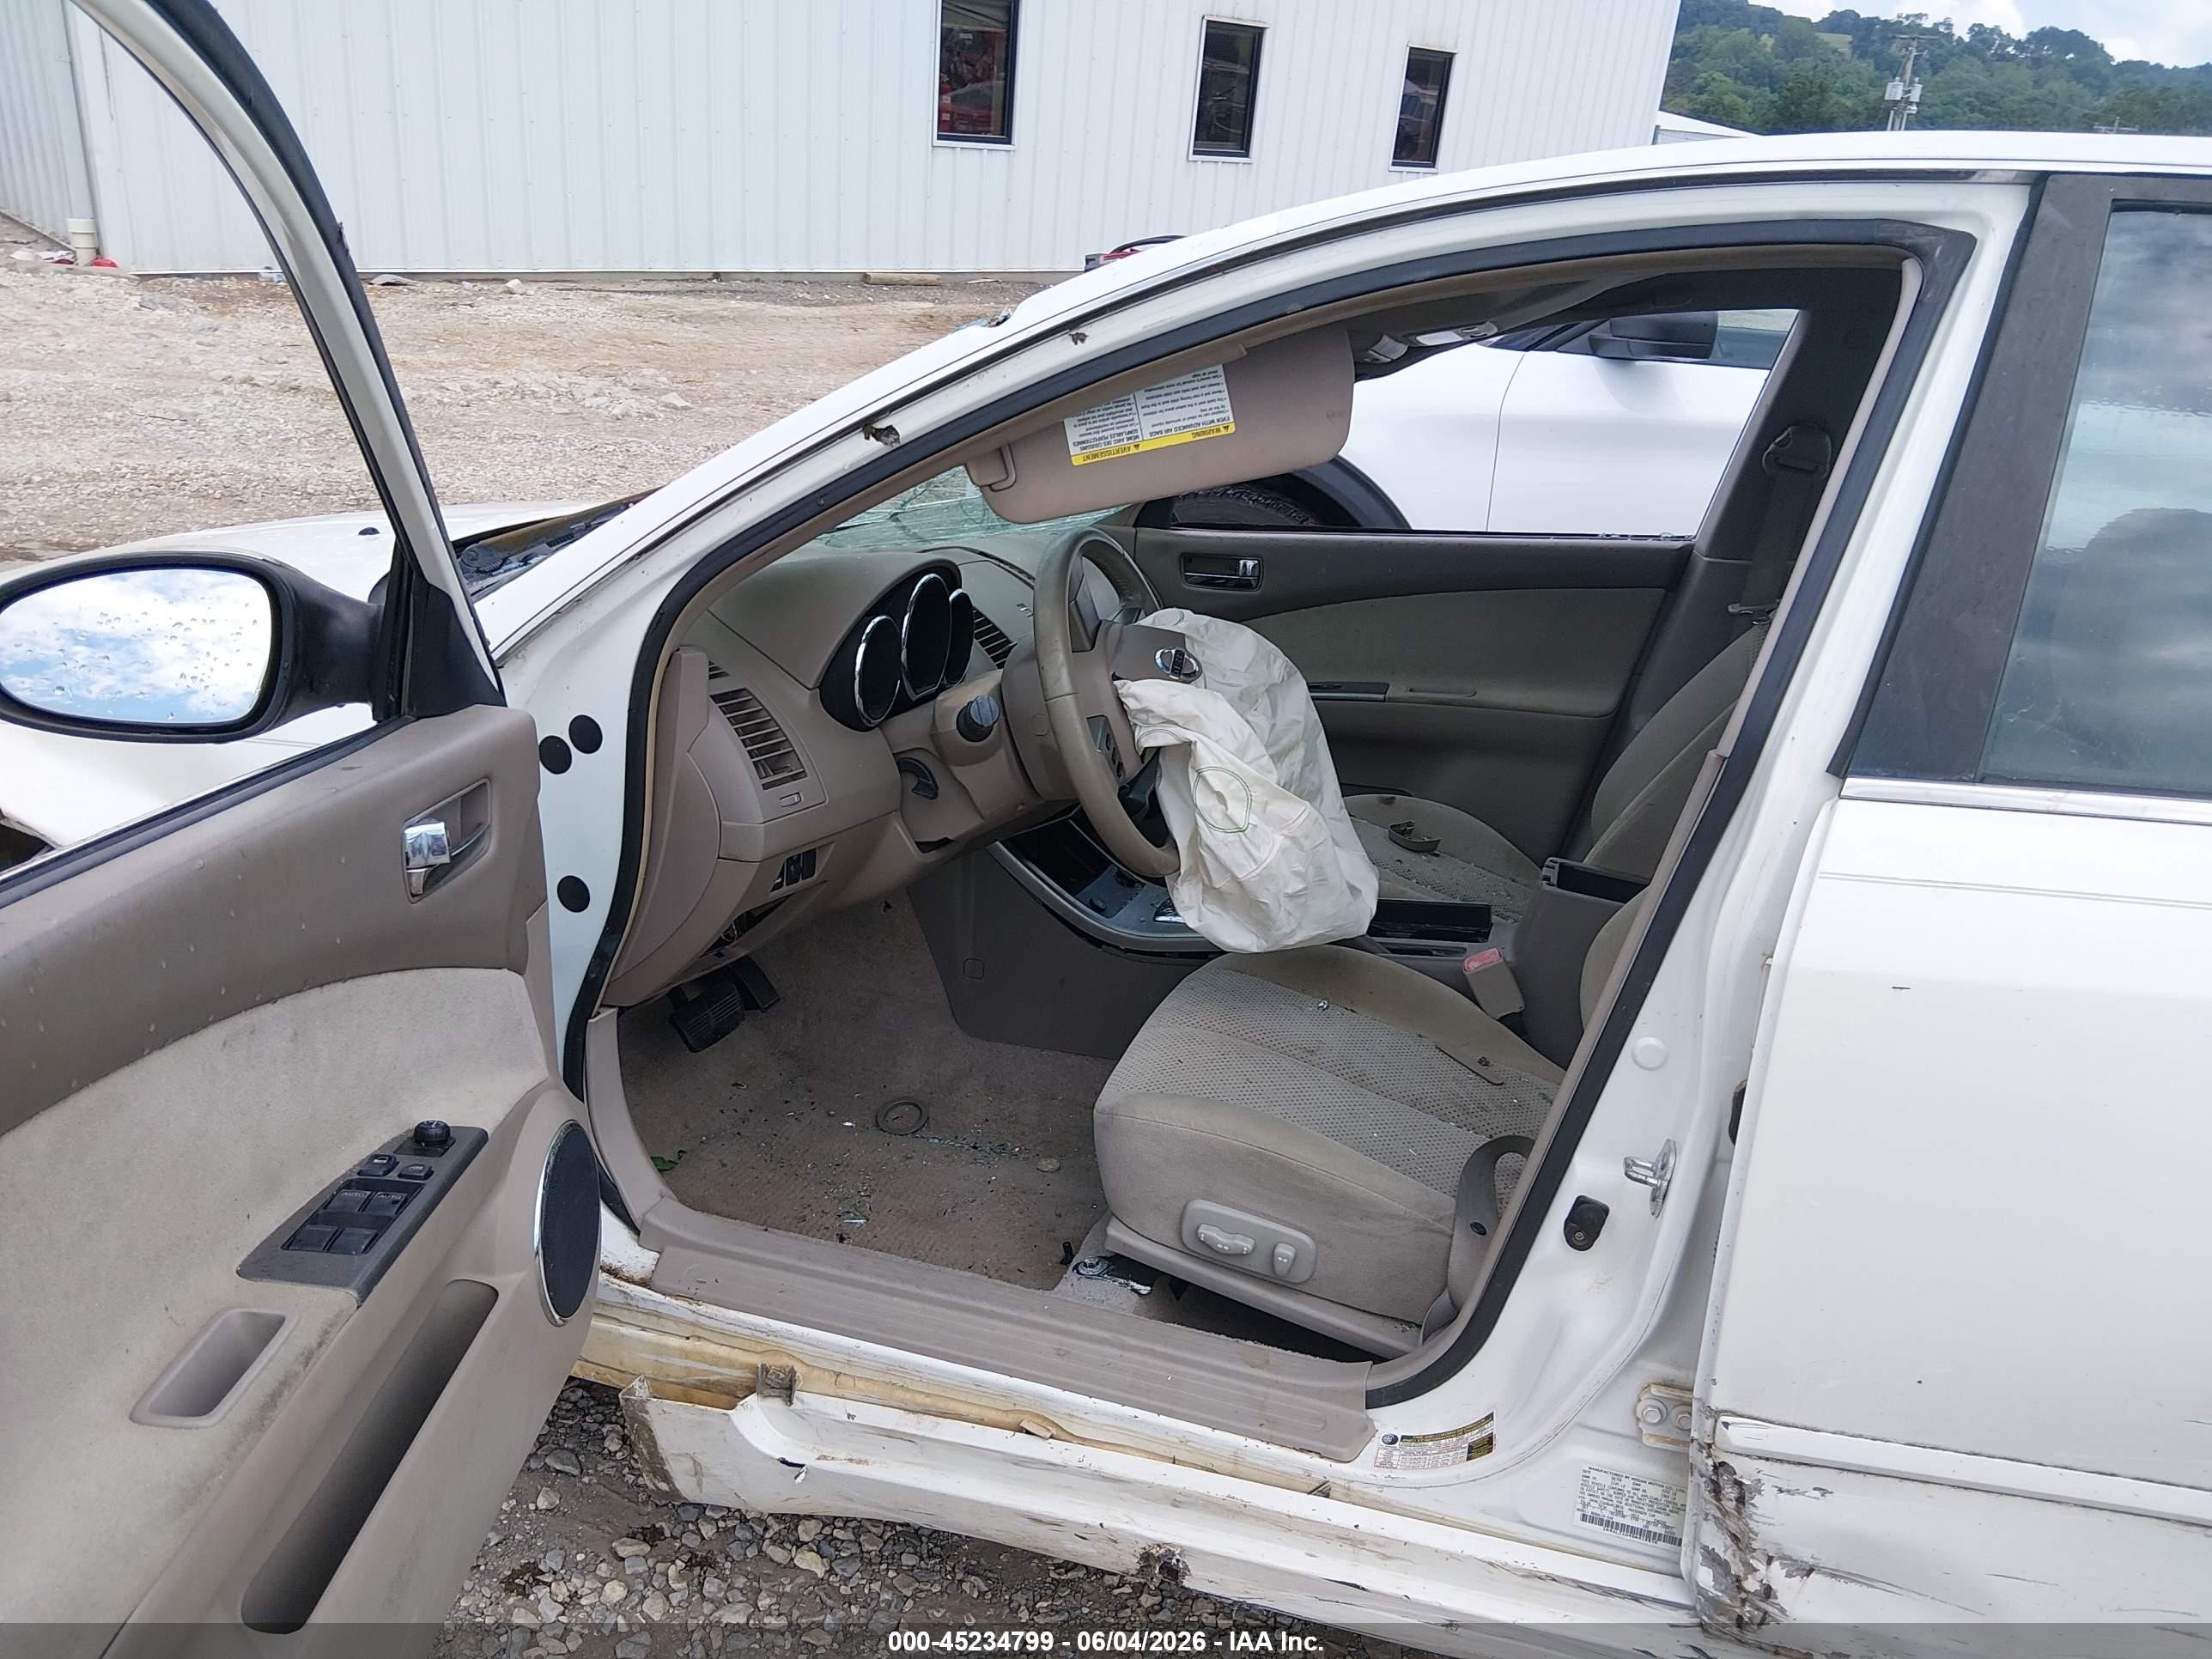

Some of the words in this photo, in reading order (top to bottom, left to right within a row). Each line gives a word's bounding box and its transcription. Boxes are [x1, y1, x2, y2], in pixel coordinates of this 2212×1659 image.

[1173, 422, 1200, 432] ADVANCED
[1191, 427, 1221, 438] WARNING
[1081, 445, 1132, 461] AVERTISSEMENT
